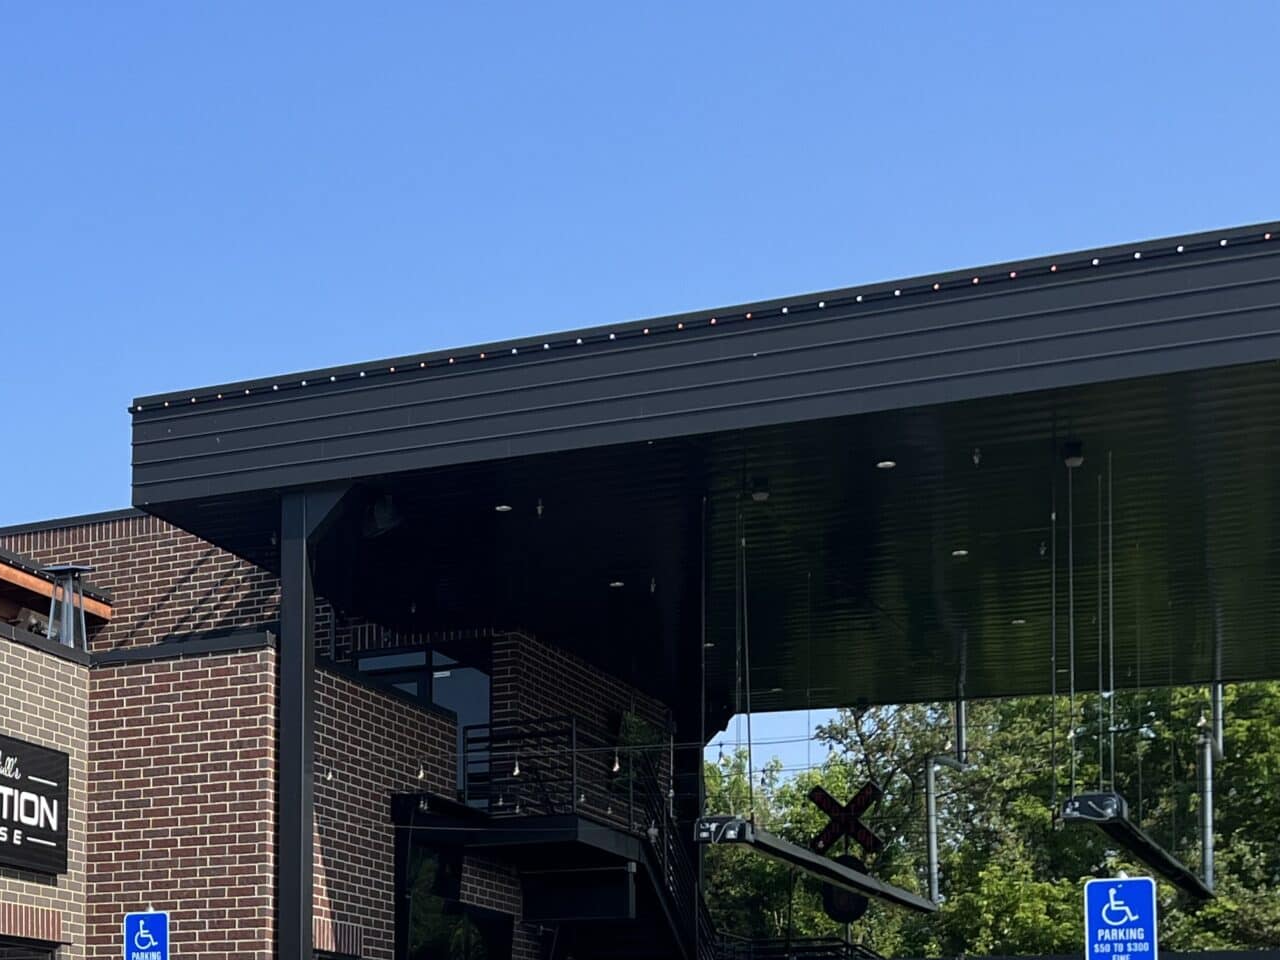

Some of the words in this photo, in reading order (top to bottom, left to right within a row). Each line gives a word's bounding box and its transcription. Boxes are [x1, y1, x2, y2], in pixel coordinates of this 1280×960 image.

[1097, 928, 1145, 941] PARKING
[1094, 943, 1111, 953] $50
[1113, 943, 1124, 952] TO
[1127, 942, 1149, 952] $300
